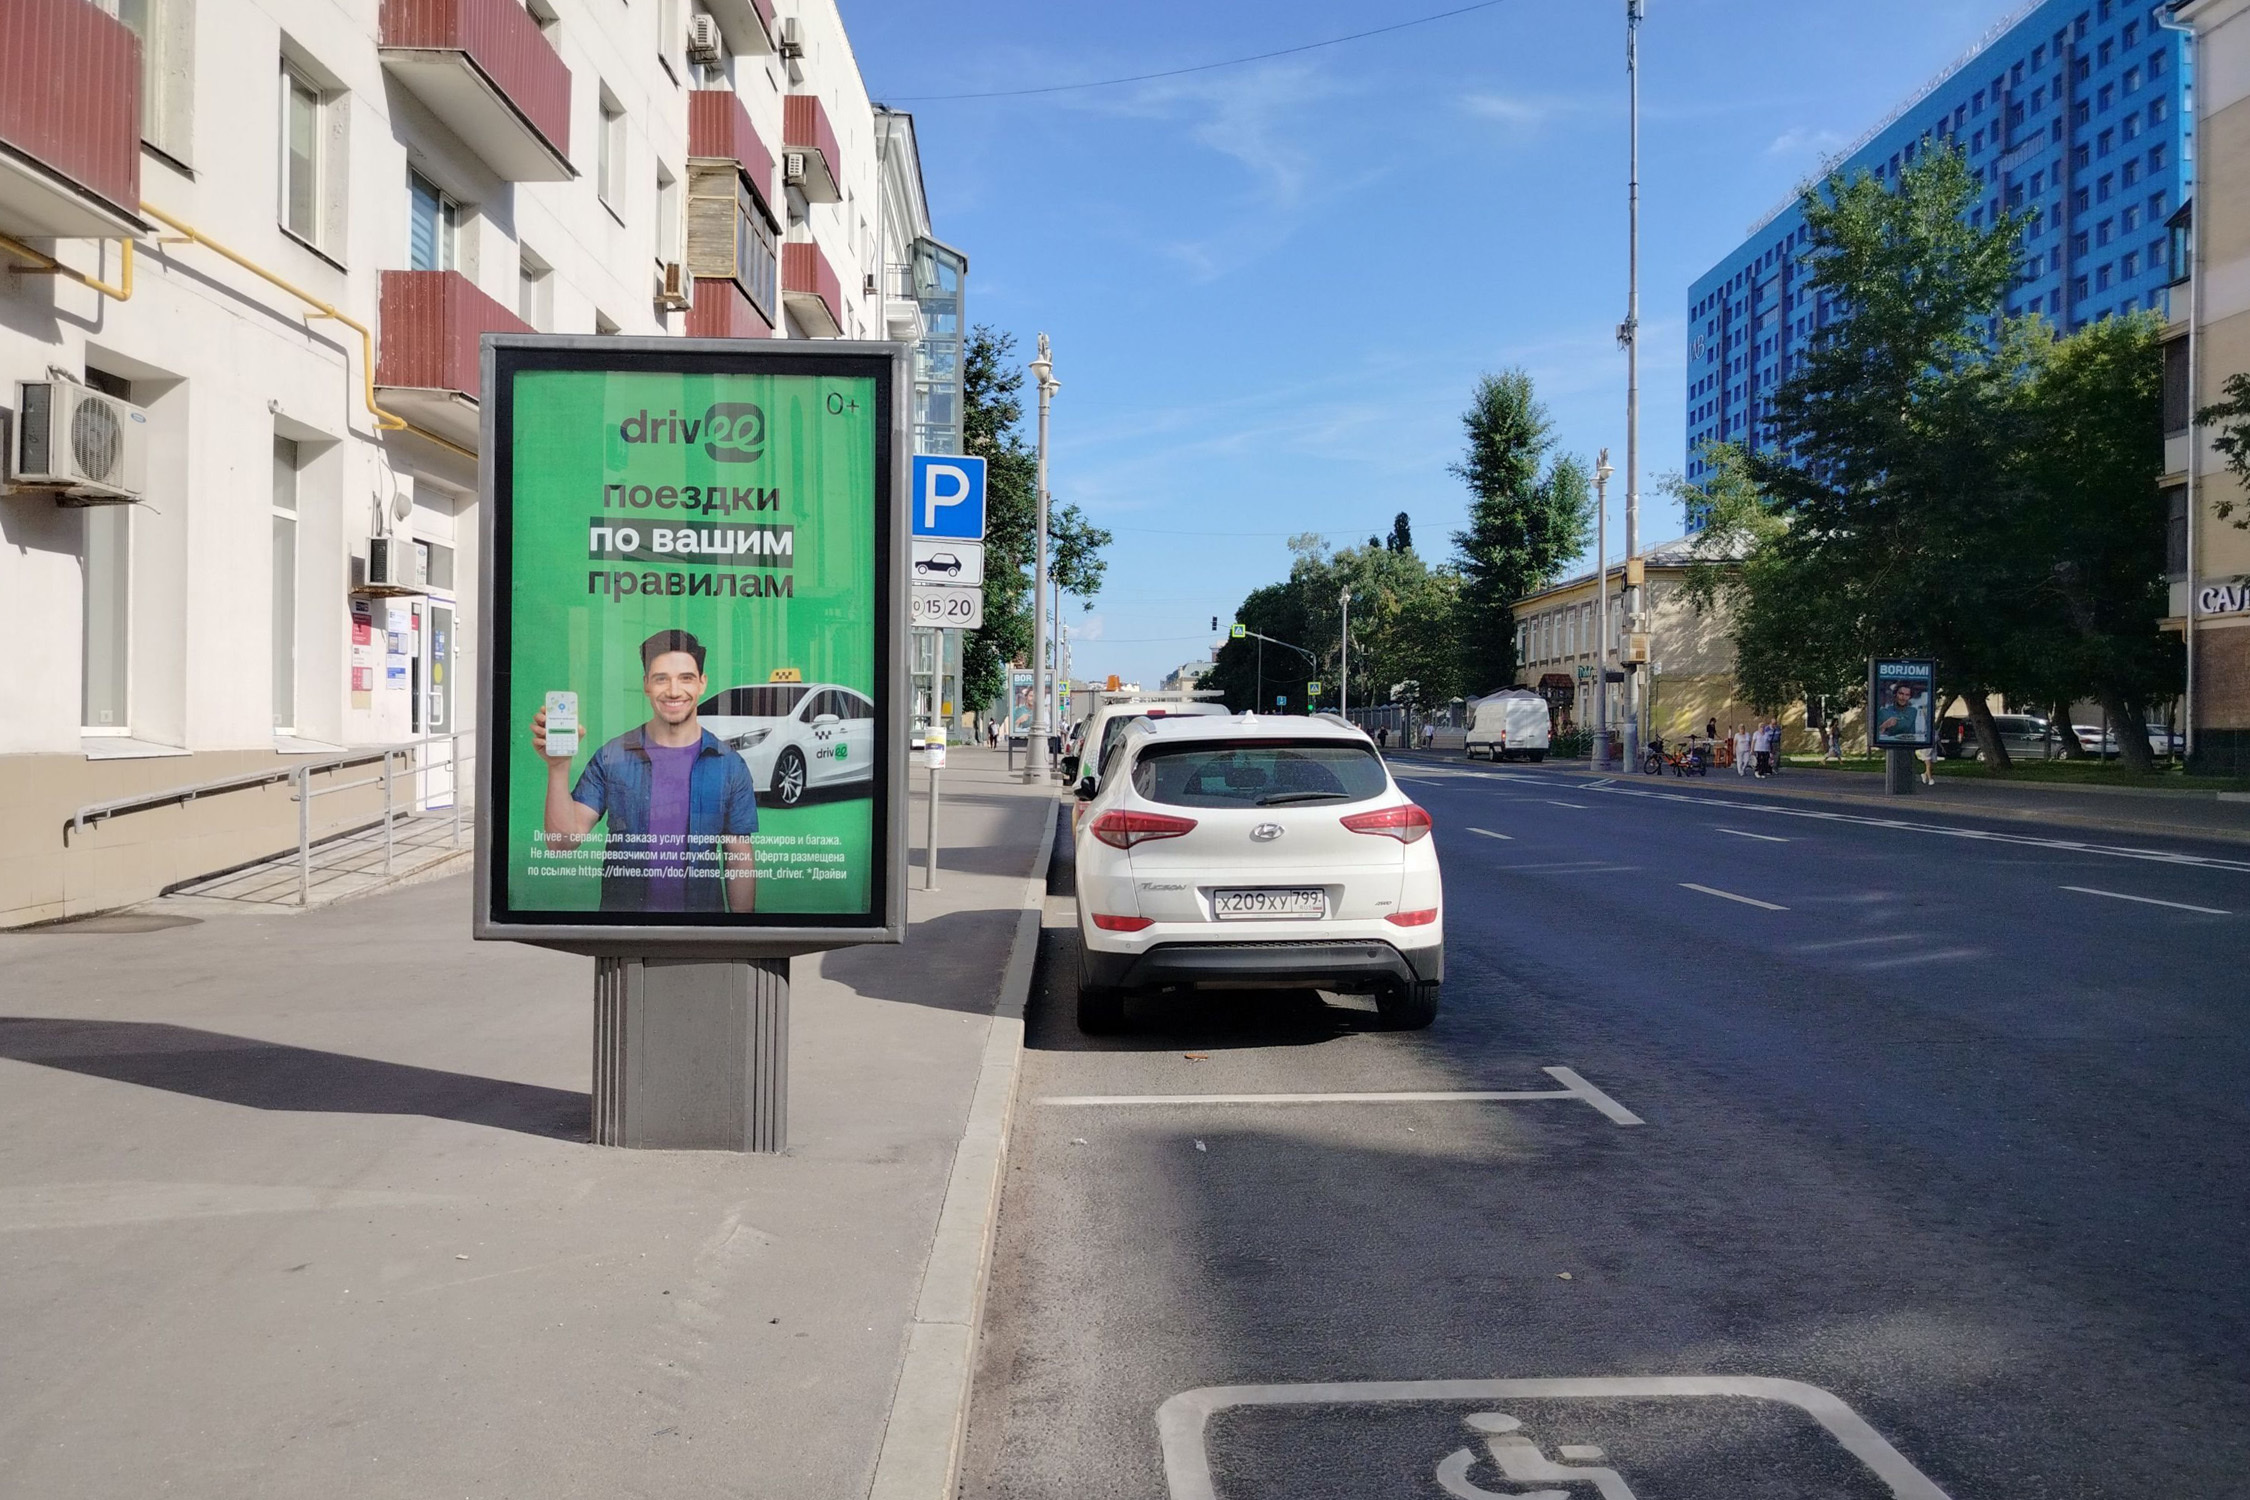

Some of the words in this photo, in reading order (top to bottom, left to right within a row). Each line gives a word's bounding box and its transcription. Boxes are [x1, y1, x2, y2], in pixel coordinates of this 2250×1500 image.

[826, 392, 860, 415] 0+
[620, 409, 765, 454] drivee
[604, 484, 780, 516] поездки
[589, 527, 640, 552] по
[652, 528, 793, 556] вашим
[588, 569, 793, 603] правилам
[926, 600, 941, 613] 15
[947, 599, 971, 616] 20
[1880, 664, 1929, 675] BORJOMI
[816, 745, 848, 759] drivee
[533, 830, 562, 842] Drivee
[569, 833, 603, 845] сервис
[604, 833, 624, 845] для
[625, 834, 657, 843] заказа
[659, 834, 686, 846] услуг
[687, 834, 737, 846] перевозки
[738, 835, 796, 846] пассажиров
[797, 836, 804, 845] и
[805, 833, 842, 846] багажа.
[530, 847, 542, 859] Не
[543, 849, 589, 860] является
[590, 850, 658, 861] перевозчиком
[659, 851, 678, 861] или
[679, 849, 722, 862] службой
[723, 852, 753, 861] такси.
[754, 851, 789, 864] Оферта
[790, 852, 845, 864] размещена
[527, 866, 539, 876] по
[540, 866, 577, 877] ссылке
[1292, 891, 1318, 905] 799
